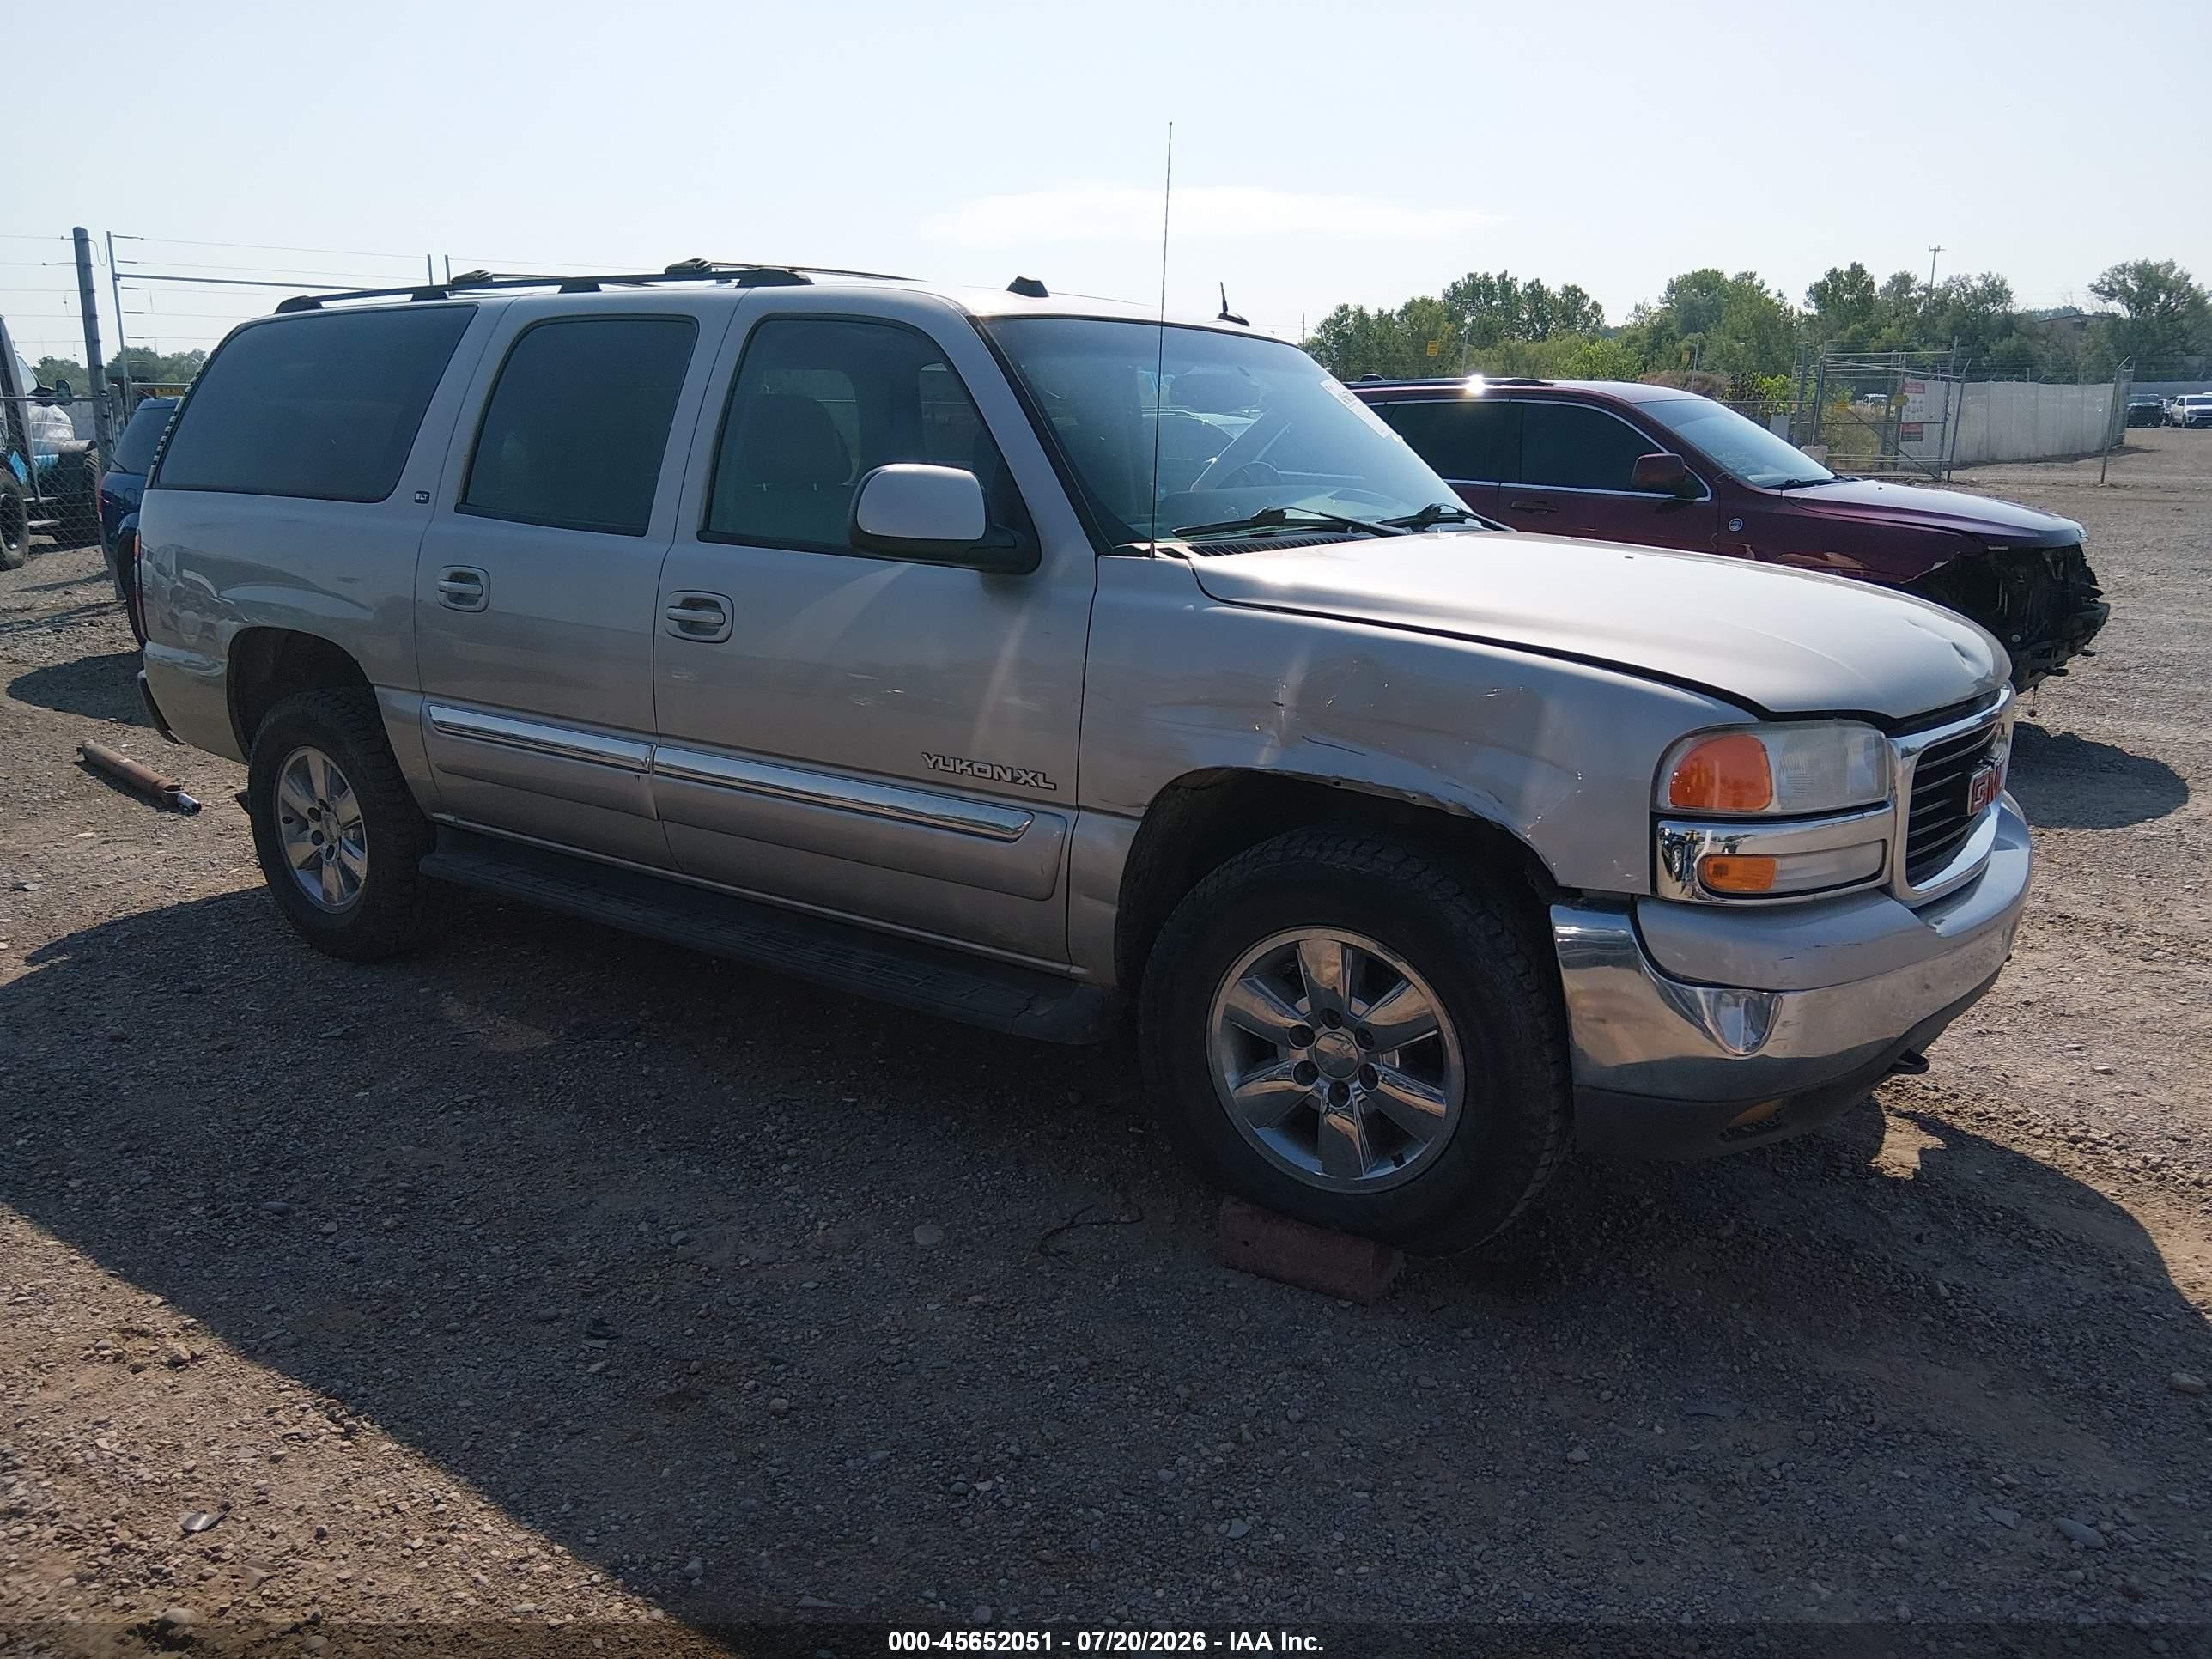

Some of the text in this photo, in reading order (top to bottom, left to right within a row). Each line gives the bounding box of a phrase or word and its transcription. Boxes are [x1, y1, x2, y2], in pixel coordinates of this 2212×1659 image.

[921, 751, 1057, 790] YUKON XL
[1967, 752, 2005, 817] GM
